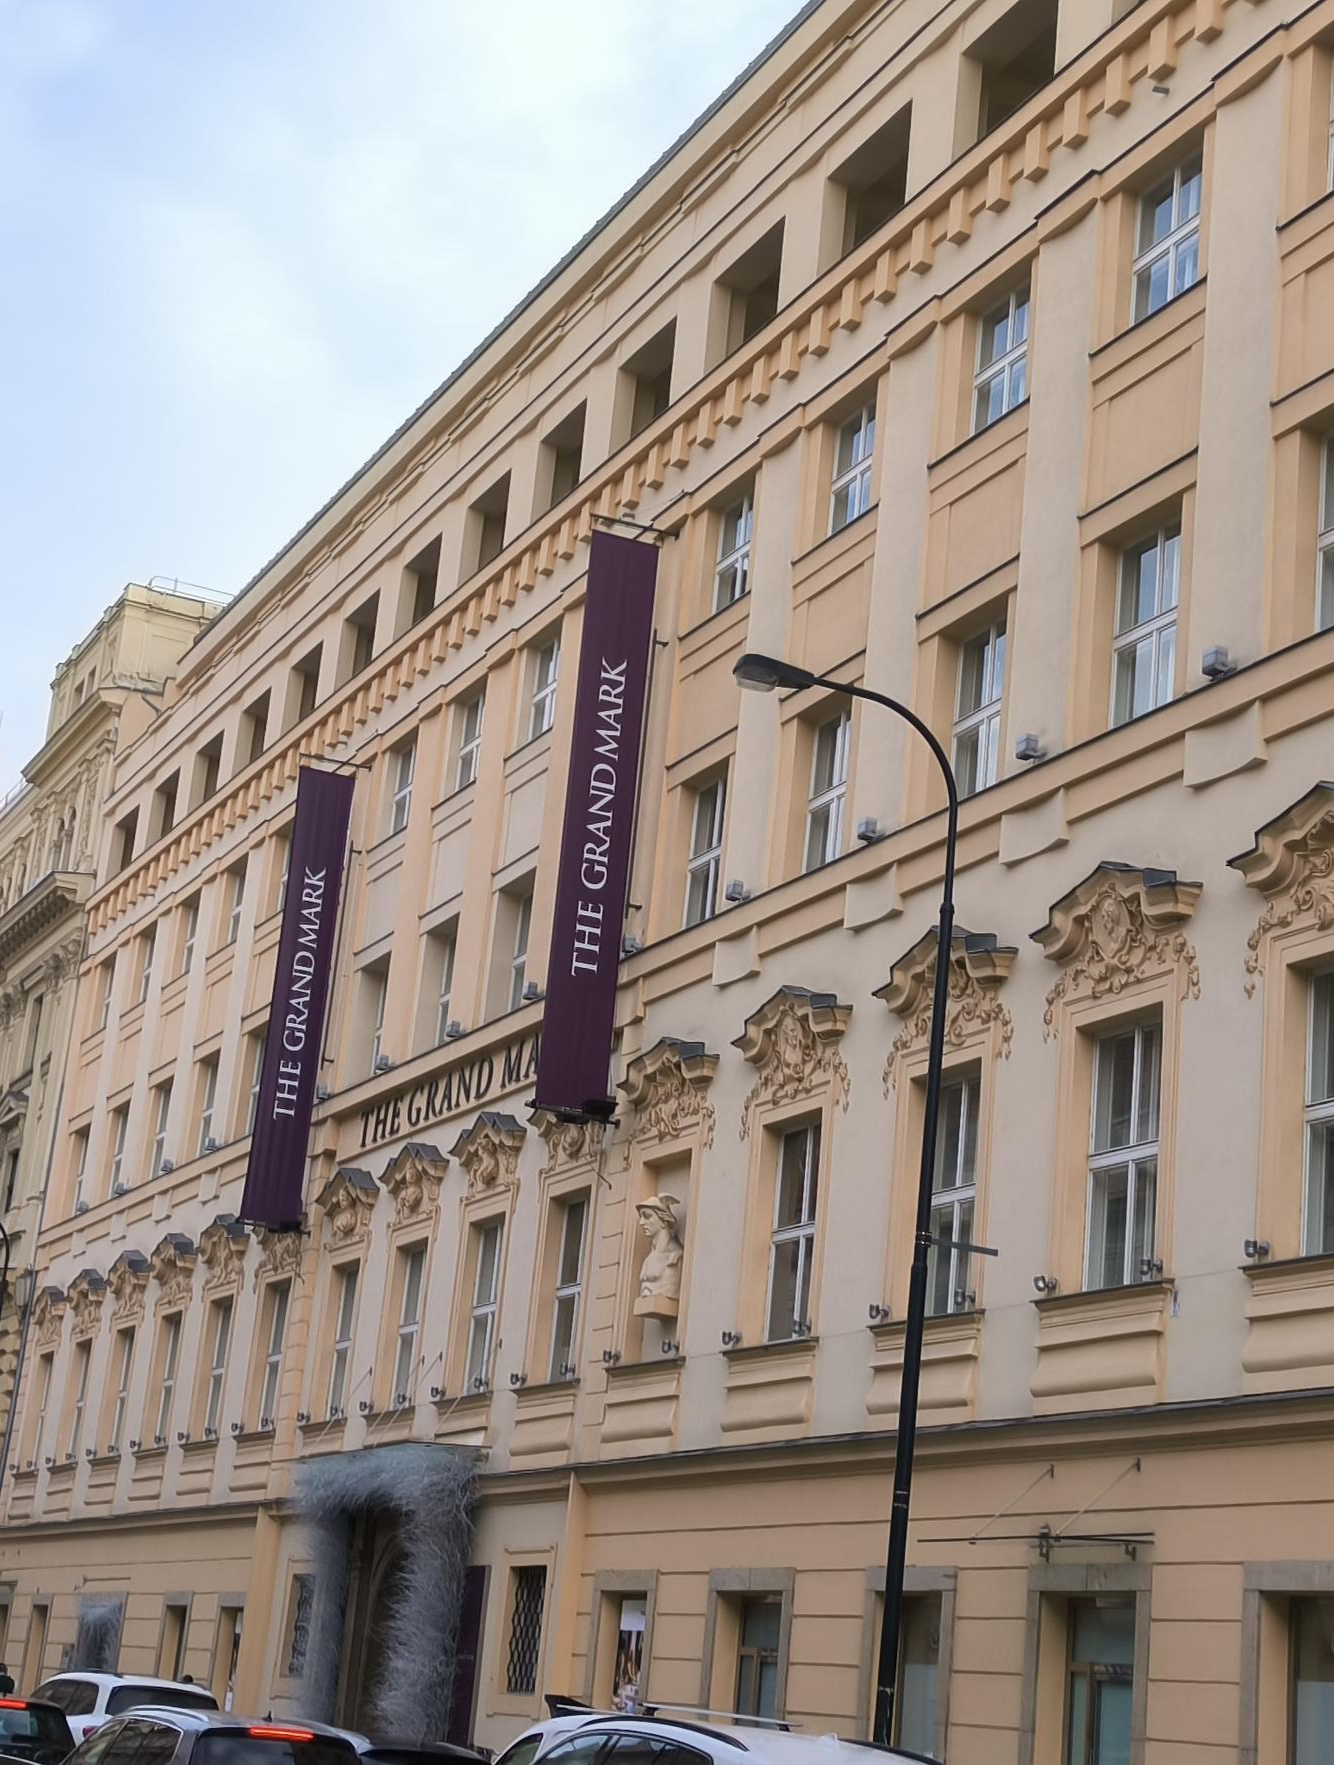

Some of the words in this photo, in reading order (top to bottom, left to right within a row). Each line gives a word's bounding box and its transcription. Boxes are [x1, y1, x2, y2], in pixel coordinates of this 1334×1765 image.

[571, 900, 604, 977] THE
[273, 1060, 302, 1120] THE
[360, 1093, 404, 1148] THE
[407, 1055, 495, 1127] GRAND
[500, 1031, 541, 1089] MA
